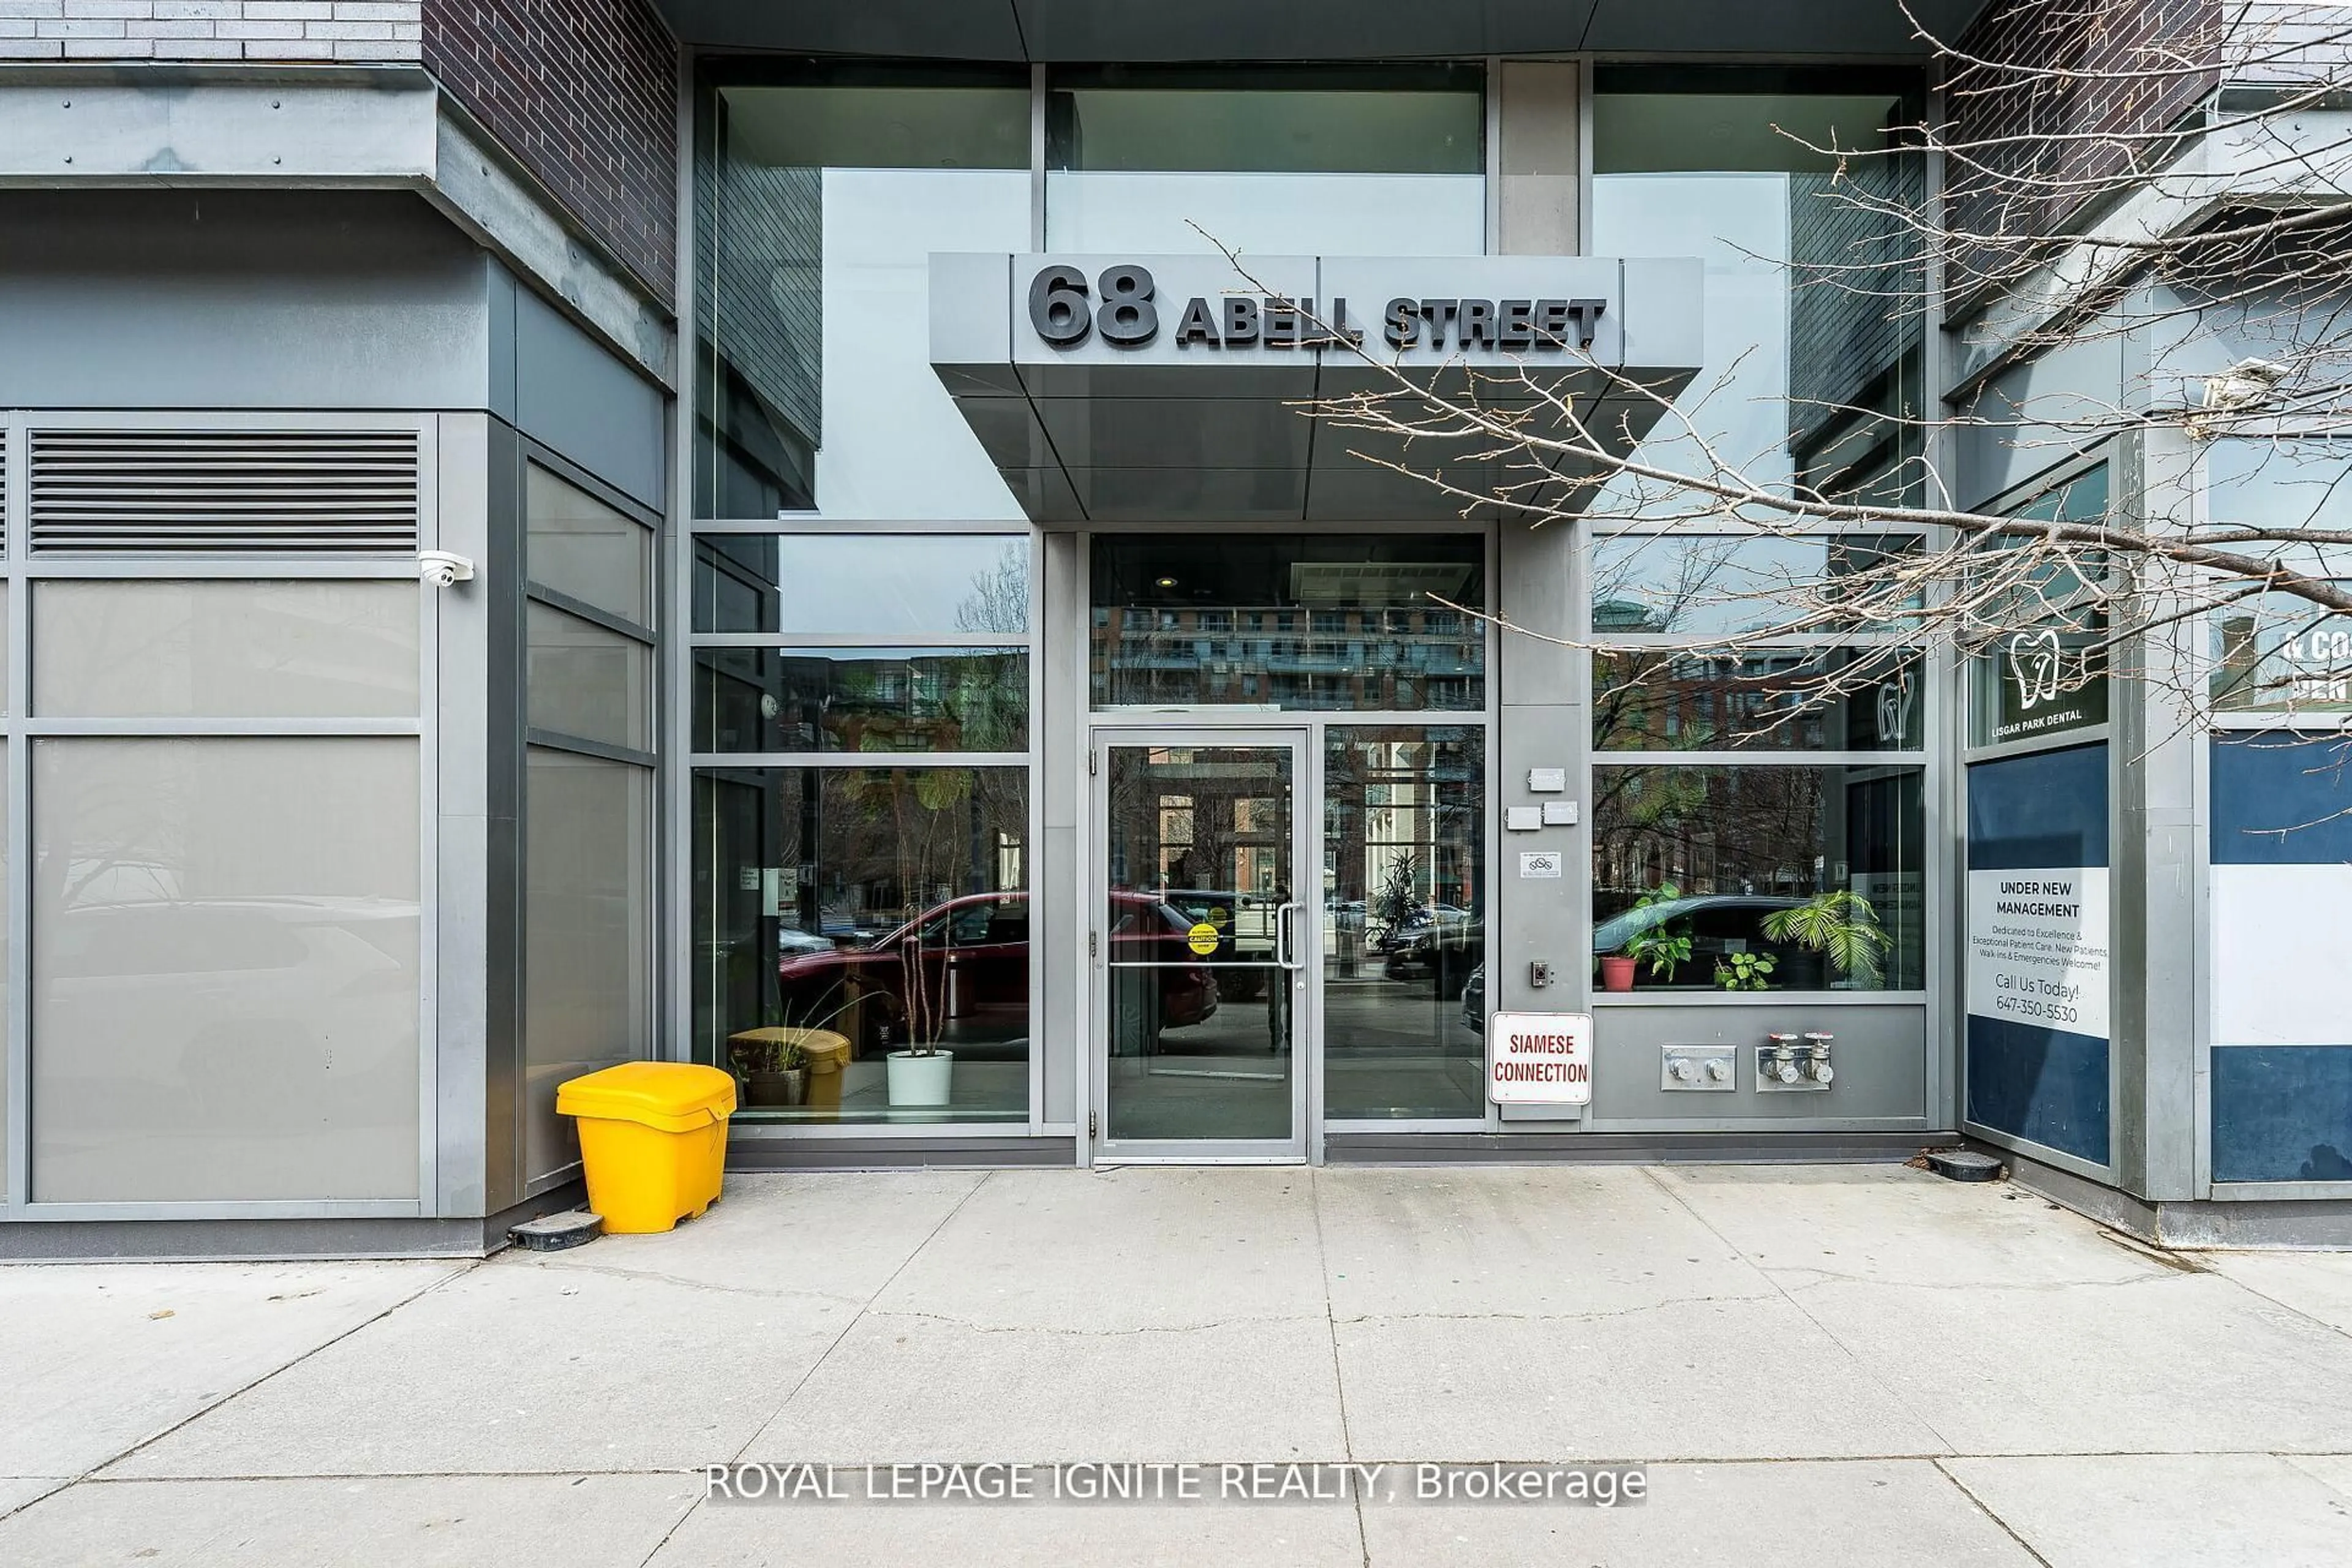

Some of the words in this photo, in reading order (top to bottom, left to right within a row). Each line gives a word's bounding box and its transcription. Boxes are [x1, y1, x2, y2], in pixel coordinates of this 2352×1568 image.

[1029, 265, 1159, 345] 68
[1176, 297, 1364, 347] ABELL
[1384, 298, 1607, 347] STREET
[1992, 723, 2021, 737] LISGAR
[2022, 717, 2046, 732] PARK
[2047, 709, 2082, 726] DENTAL
[2000, 882, 2040, 895] UNDER
[2043, 882, 2072, 895] NEW
[1997, 902, 2079, 918] MANAGEMENT
[1992, 925, 2026, 937] Dedicated
[2027, 929, 2035, 937] to
[2036, 927, 2075, 941] Excellence
[2076, 931, 2082, 940] &
[1973, 935, 2008, 948] Exceptional
[2010, 938, 2034, 950] Patient
[2055, 943, 2073, 954] New
[2008, 951, 2013, 960] &
[2013, 951, 2060, 966] Emergencies
[2061, 957, 2100, 971] Welcome!
[1996, 973, 2016, 990] Call
[2020, 977, 2035, 992] Us
[2037, 979, 2079, 1002] Today!
[1996, 995, 2078, 1023] 647-350-5530
[1510, 1035, 1574, 1054] SIAMESE
[1494, 1061, 1588, 1083] CONNECTION
